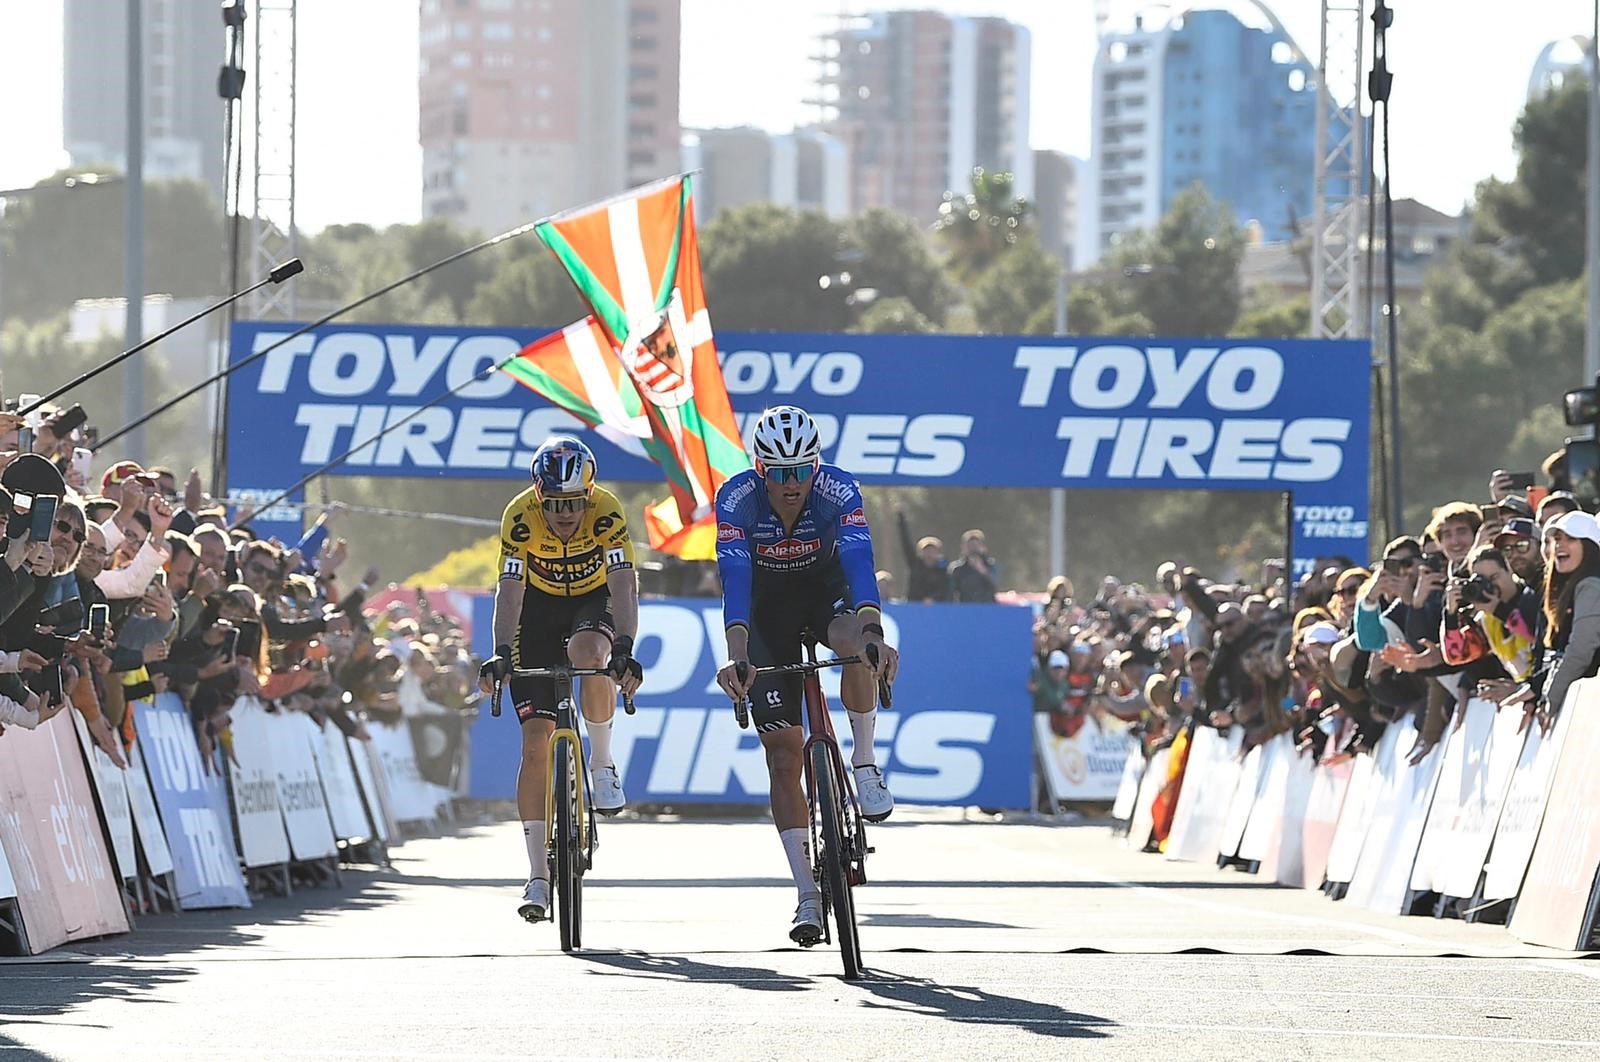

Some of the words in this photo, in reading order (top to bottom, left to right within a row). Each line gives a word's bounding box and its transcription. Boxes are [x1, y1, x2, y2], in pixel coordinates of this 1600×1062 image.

[252, 332, 522, 400] TOYO
[718, 350, 864, 396] OYO
[1013, 344, 1285, 411] TOYO
[1055, 417, 1352, 482] TIRES
[814, 471, 855, 503] Alpecin
[1293, 505, 1355, 521] TOYO
[1302, 521, 1369, 538] TIRES
[608, 551, 621, 565] 11
[764, 543, 814, 556] Alpecin
[507, 561, 520, 575] 11
[757, 556, 817, 569] deceuninck
[144, 710, 219, 792] TOY
